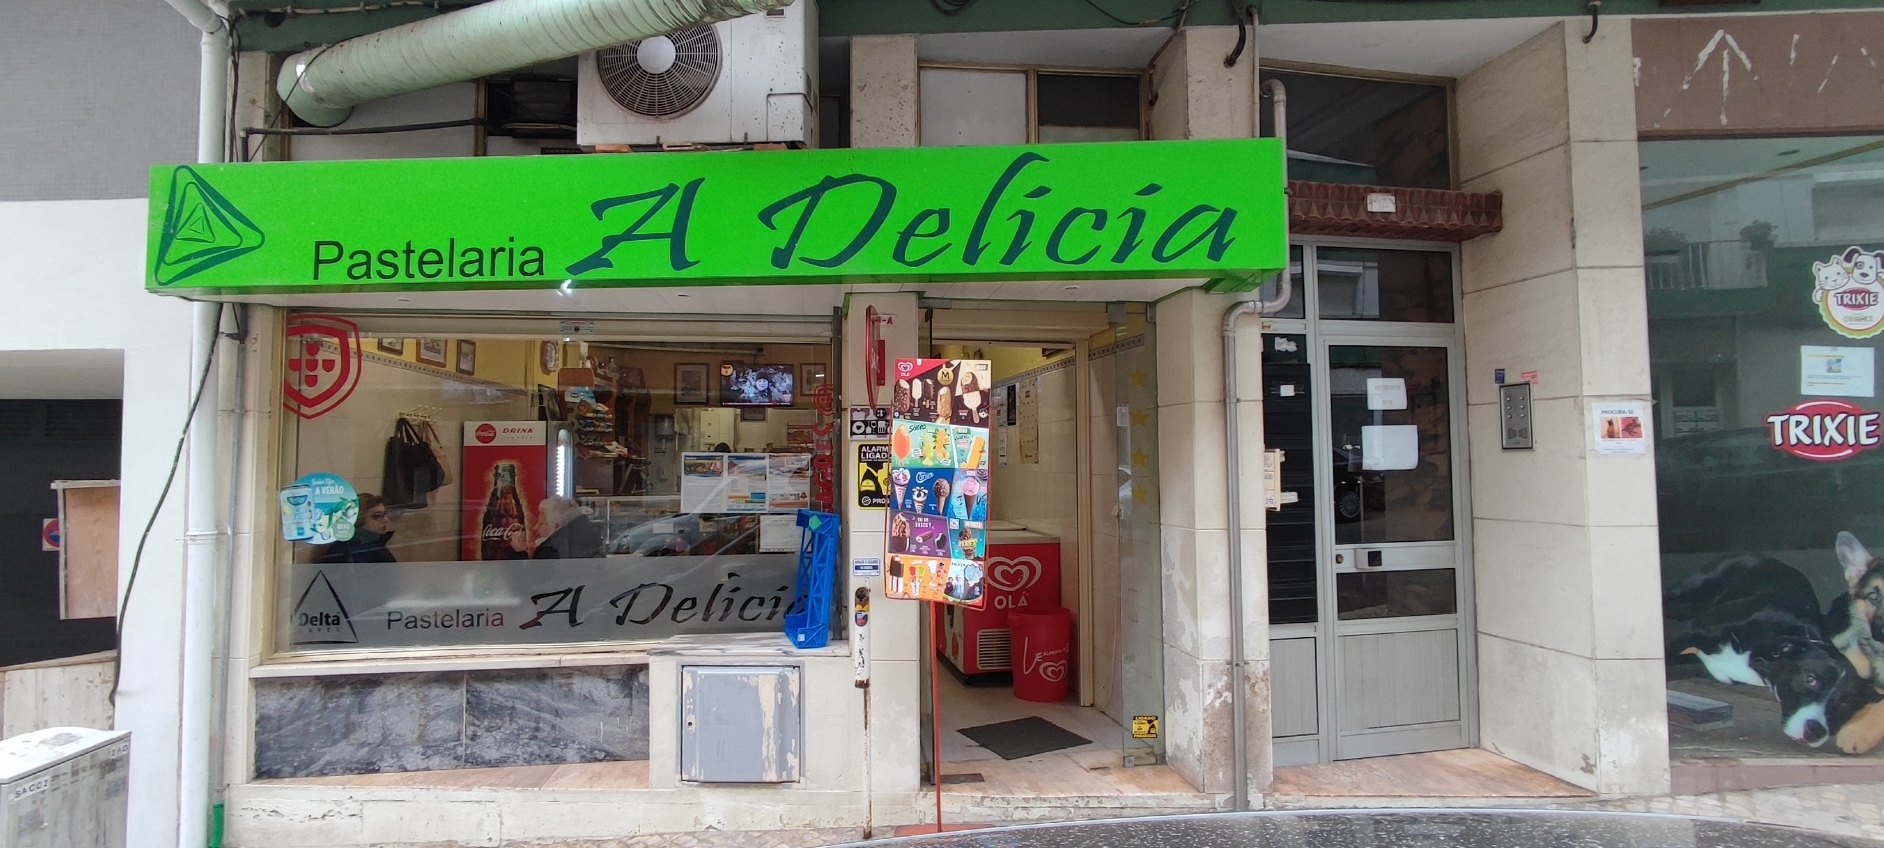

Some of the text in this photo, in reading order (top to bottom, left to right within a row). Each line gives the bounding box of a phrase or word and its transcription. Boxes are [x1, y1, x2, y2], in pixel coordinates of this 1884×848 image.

[313, 151, 1238, 281] Pastelaria A Delicia
[1834, 292, 1879, 307] TRIXIE
[1766, 412, 1880, 447] TRIXIE
[861, 445, 889, 453] ALARM
[322, 485, 344, 495] VERÃO
[387, 608, 504, 630] Pastelaria
[519, 585, 586, 629] A
[994, 591, 1029, 609] OLÁ
[299, 612, 340, 627] Delta
